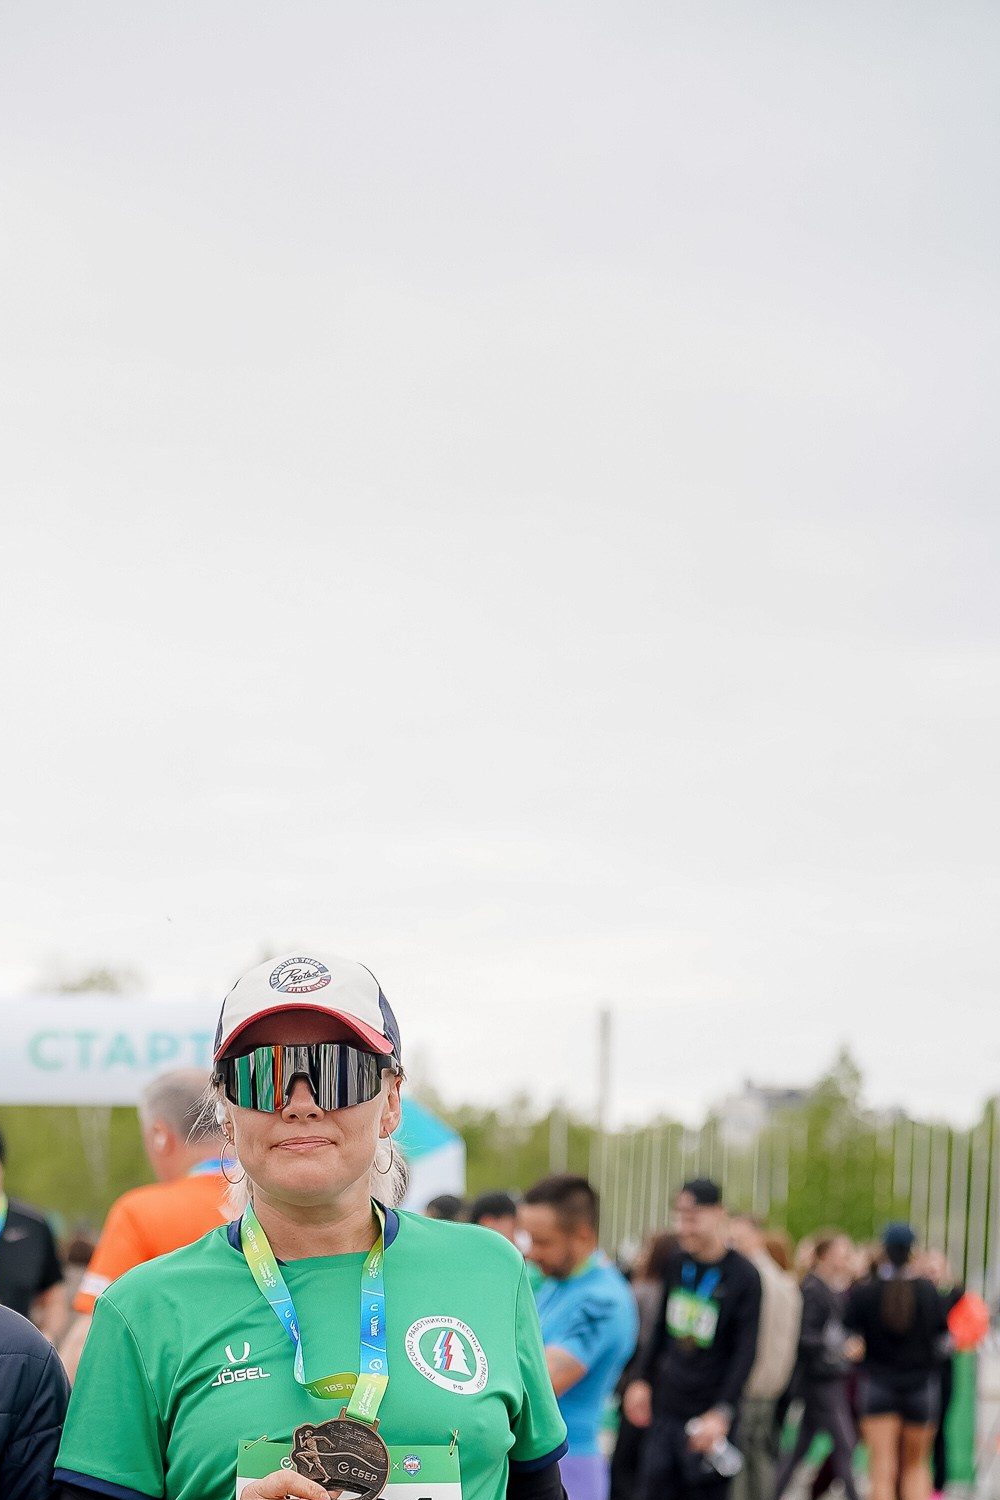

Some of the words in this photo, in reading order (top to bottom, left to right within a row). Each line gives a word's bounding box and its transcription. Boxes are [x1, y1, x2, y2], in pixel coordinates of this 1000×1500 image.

[28, 1031, 213, 1072] СТАРТ
[408, 1317, 454, 1339] РАБОТНИКОВ
[456, 1321, 482, 1353] ЛЕСНЫХ
[407, 1339, 436, 1381] ПРОФСОЮЗ
[211, 1367, 271, 1387] JÖGEL
[323, 1383, 344, 1393] 185
[351, 1467, 378, 1482] СБЕР
